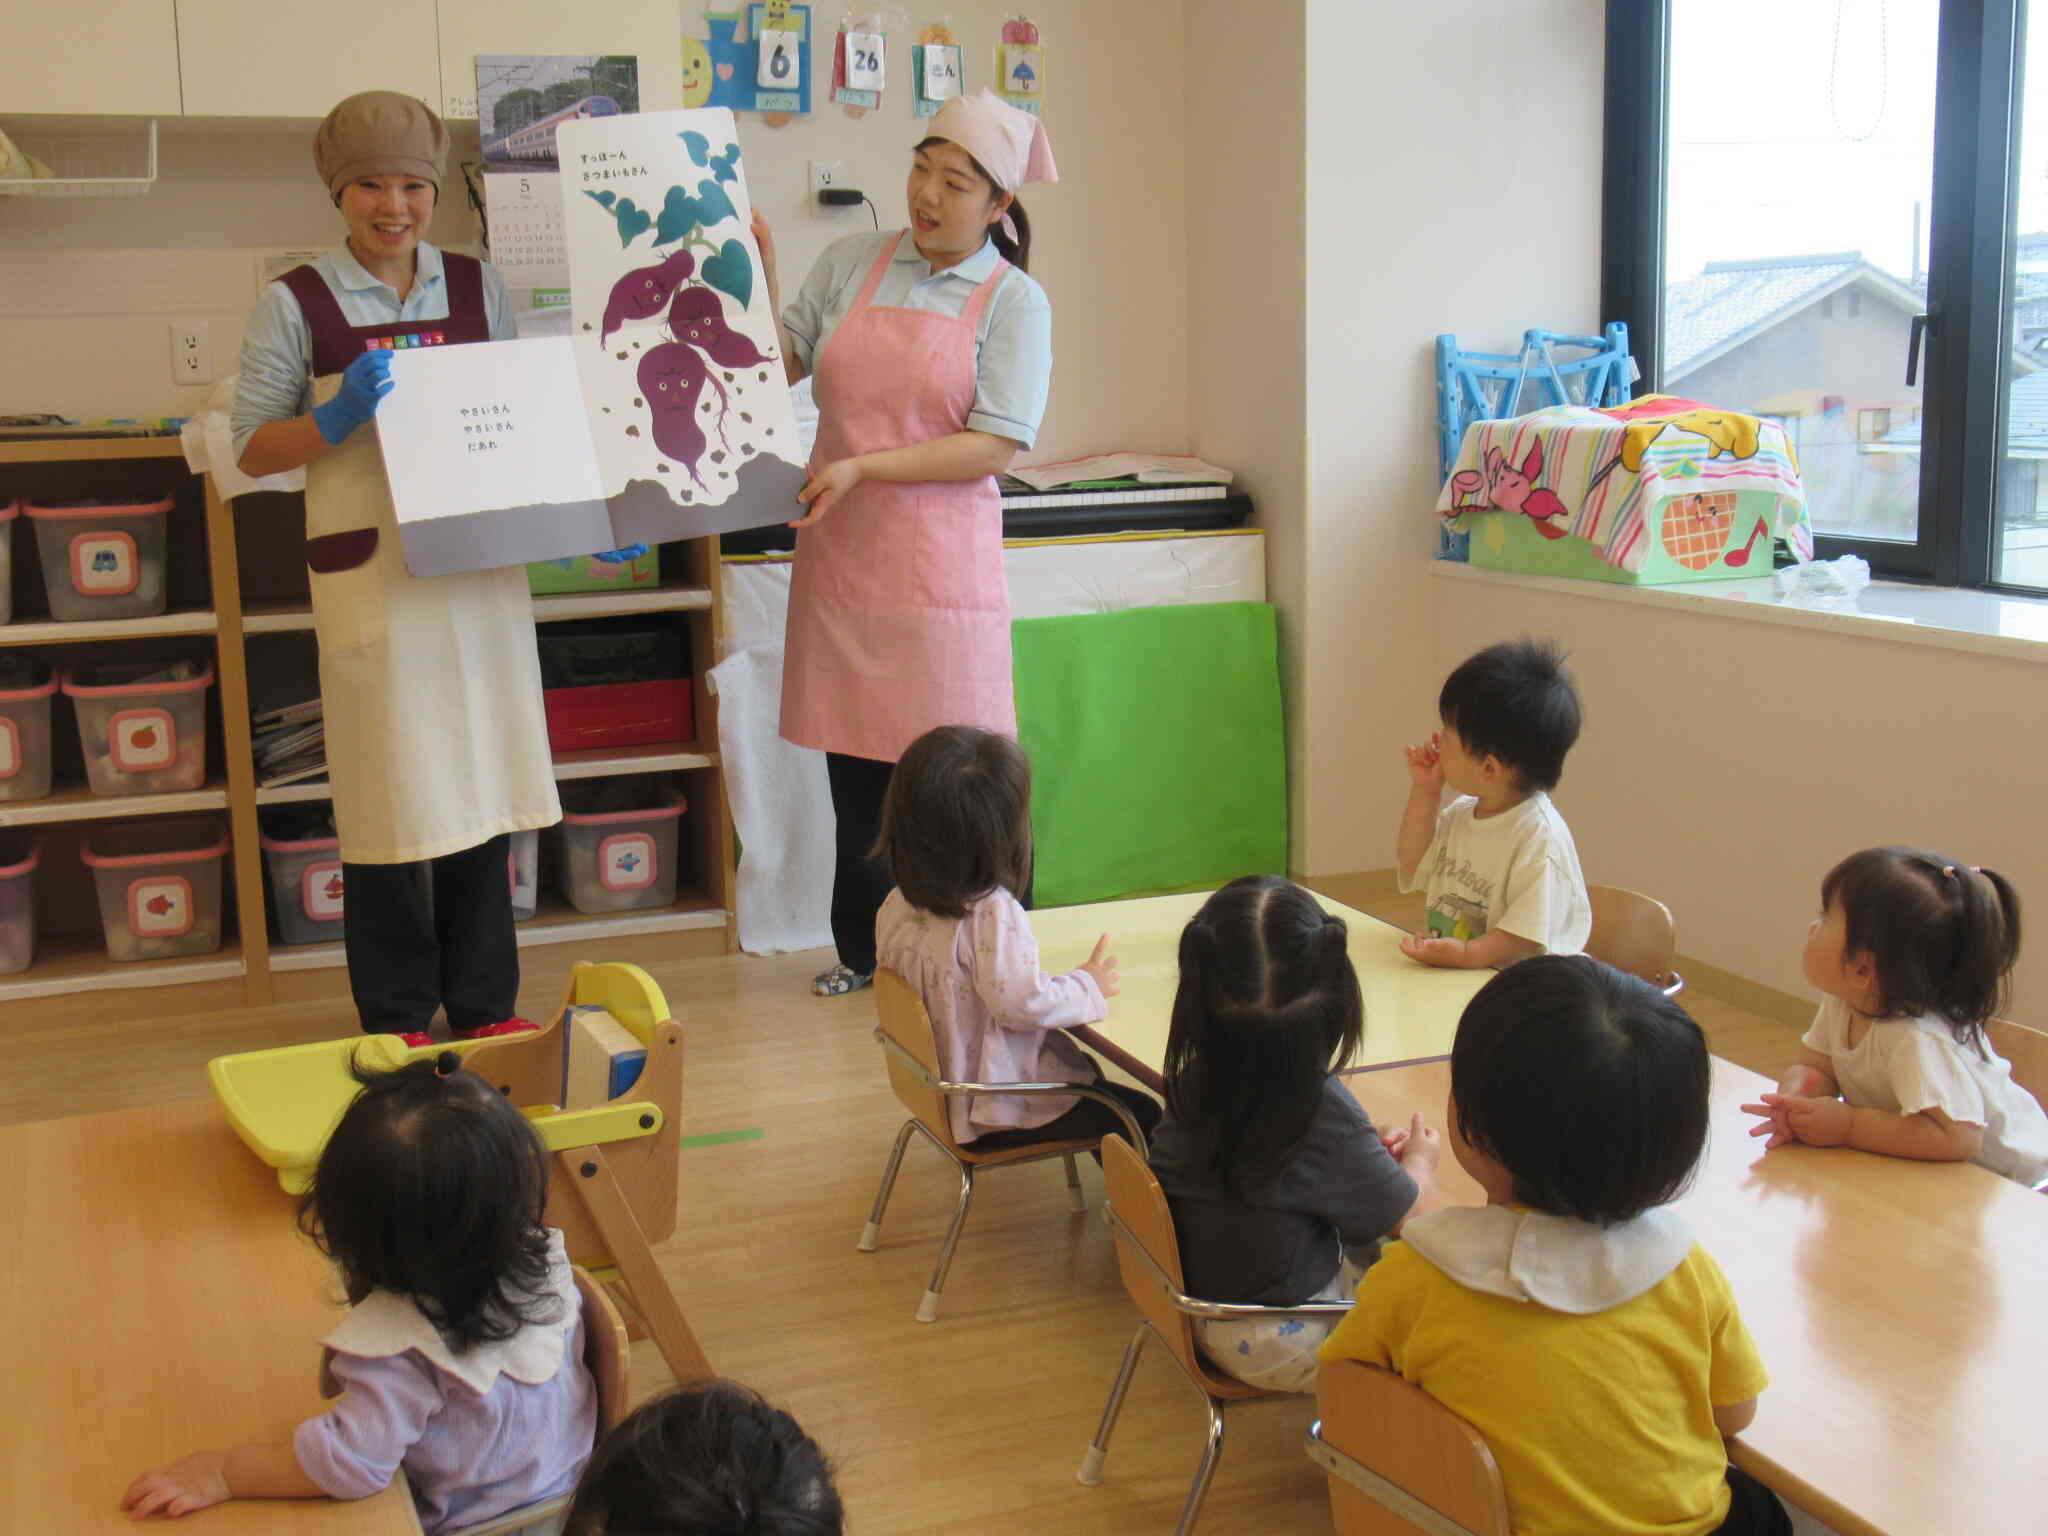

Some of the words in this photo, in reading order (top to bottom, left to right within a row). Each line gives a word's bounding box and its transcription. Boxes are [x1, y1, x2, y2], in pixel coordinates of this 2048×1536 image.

[770, 44, 791, 79] 6
[854, 49, 879, 72] 26
[583, 166, 649, 182] さつまいもさん
[520, 177, 531, 193] 5
[460, 404, 511, 417] やさいさん
[464, 420, 514, 434] やさいさん
